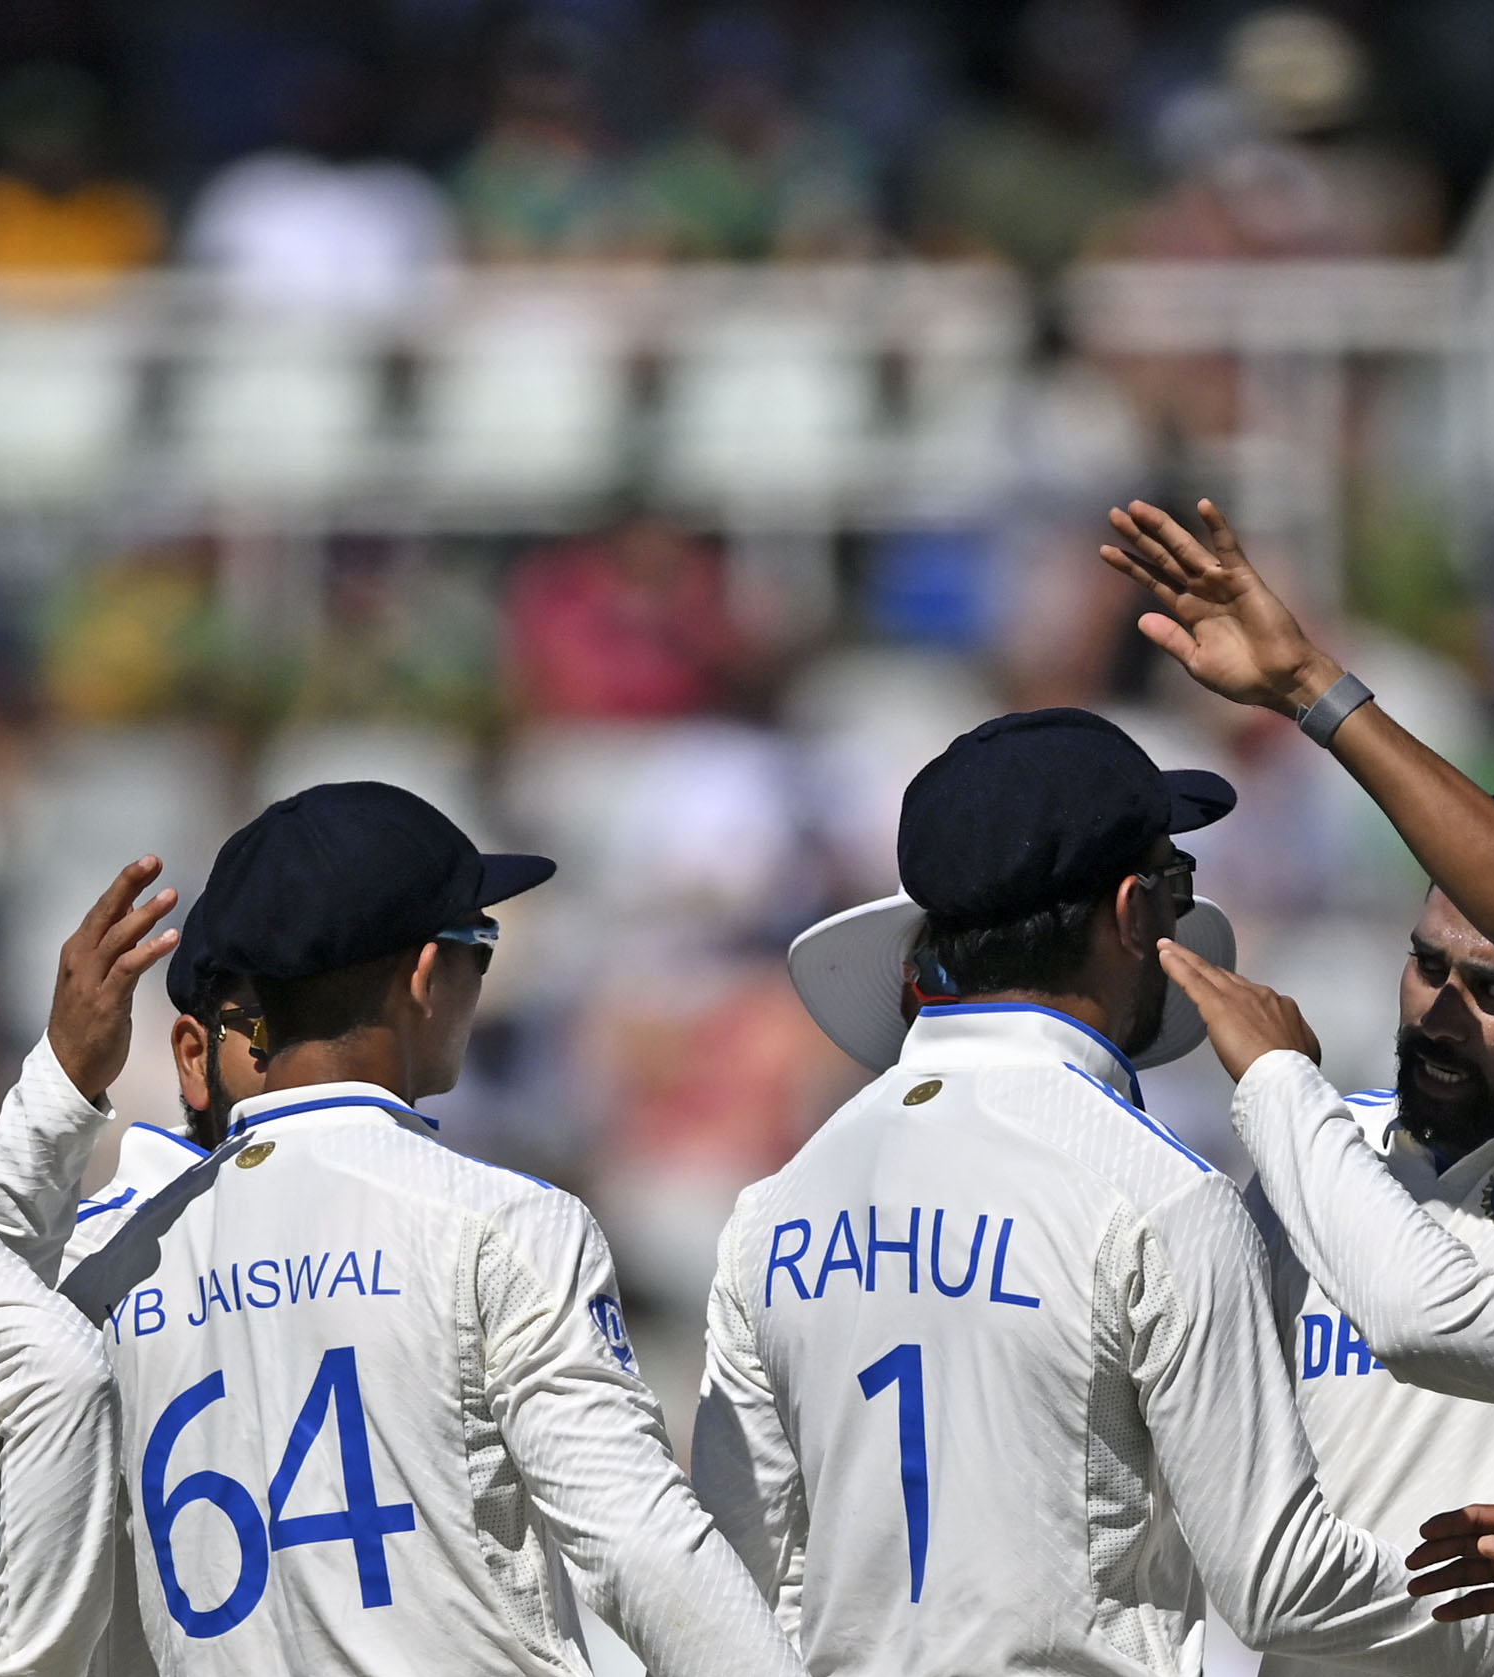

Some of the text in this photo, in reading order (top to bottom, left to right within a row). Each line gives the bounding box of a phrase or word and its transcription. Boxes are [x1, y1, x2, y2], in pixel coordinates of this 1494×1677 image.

[106, 1248, 402, 1345] YB JAISWAL
[764, 1205, 1042, 1309] RAHUL
[1301, 1311, 1388, 1381] DR
[140, 1345, 417, 1640] 64
[857, 1343, 931, 1604] 1
